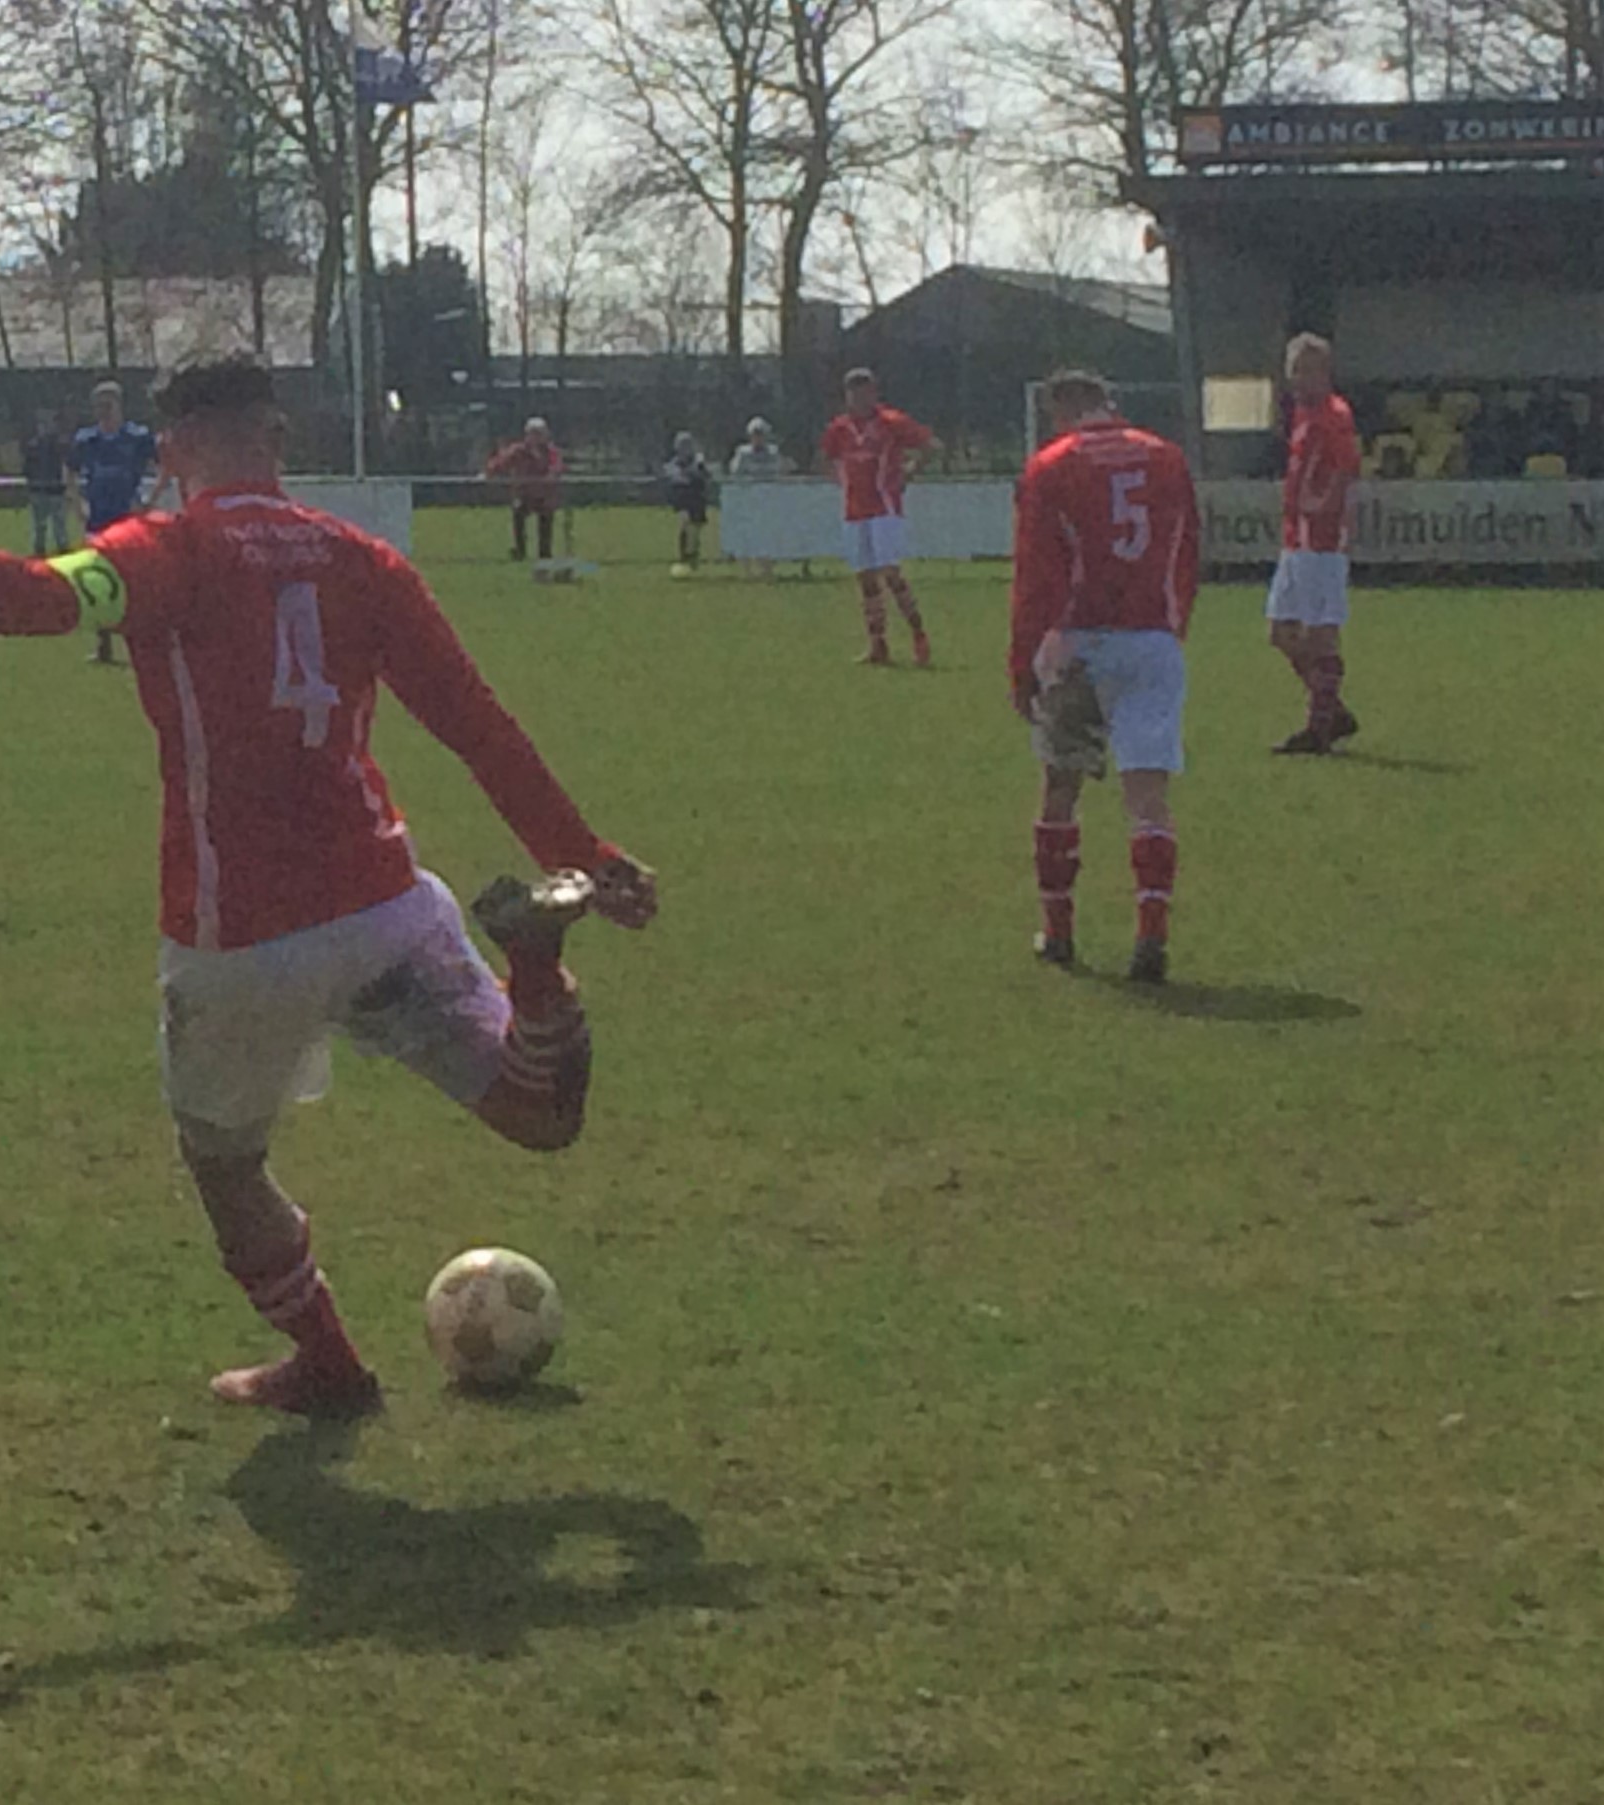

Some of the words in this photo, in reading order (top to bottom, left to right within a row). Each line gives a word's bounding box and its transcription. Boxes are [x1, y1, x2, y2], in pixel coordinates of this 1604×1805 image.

[1227, 120, 1390, 145] AMBIANCE
[1109, 470, 1152, 562] 5
[73, 565, 119, 606] C
[272, 580, 341, 748] 4
